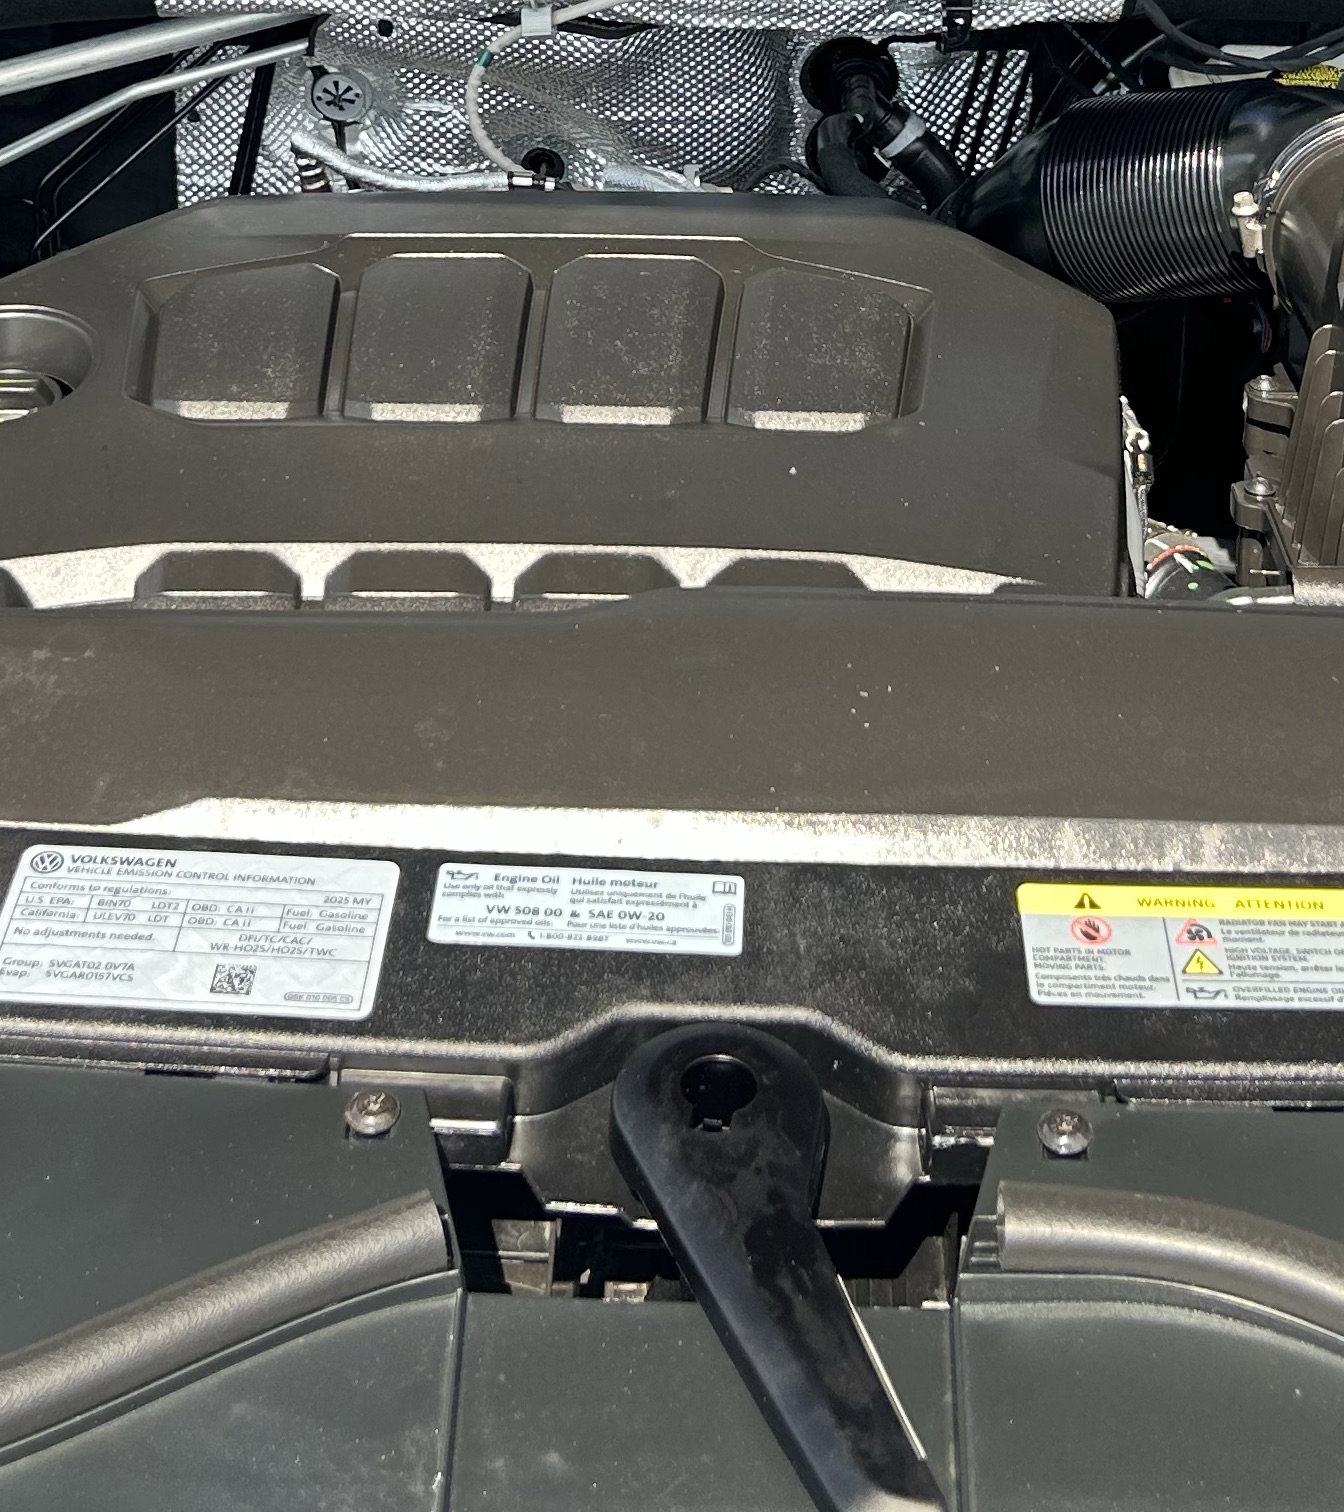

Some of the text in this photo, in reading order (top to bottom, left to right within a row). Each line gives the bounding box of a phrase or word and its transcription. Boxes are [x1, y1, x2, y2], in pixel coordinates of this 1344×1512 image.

[71, 854, 177, 868] VOLKSWAGEN
[67, 865, 316, 886] VEHICLE EMISSION CONTROL INFORMATION
[494, 873, 560, 884] Engine Oil
[30, 881, 171, 896] Conforms to regulations:
[572, 877, 658, 889] Huile moteur
[517, 886, 558, 895] expressly
[607, 890, 663, 899] uniquement
[97, 899, 180, 911] BIN70 LDT2
[323, 895, 373, 906] 2025 MY
[587, 897, 622, 905] satisfait
[1137, 897, 1324, 910] WARNING ATTENTION
[93, 912, 170, 923] ULEV70 LDT
[319, 909, 369, 921] Gasoline
[486, 905, 511, 914] VW
[515, 906, 540, 916] 508
[544, 908, 563, 917] 00
[570, 909, 580, 918] &
[588, 909, 614, 919] SAE
[462, 915, 476, 923] list
[490, 918, 533, 926] approved
[609, 922, 627, 930] liste
[13, 926, 30, 936] No
[33, 926, 106, 939] adjustments
[316, 922, 366, 934] Gasoline
[1032, 946, 1051, 954] HOT
[1054, 947, 1082, 955] PARTS
[1097, 948, 1131, 956] MOTOR
[2, 957, 43, 968] Group:
[1034, 962, 1072, 970] MOVING
[0, 968, 30, 979] Evap:
[1035, 973, 1092, 981] Composants
[1048, 982, 1116, 990] compartiment
[1233, 986, 1290, 994] OVERFILLED
[1235, 994, 1294, 1002] Remplissage
